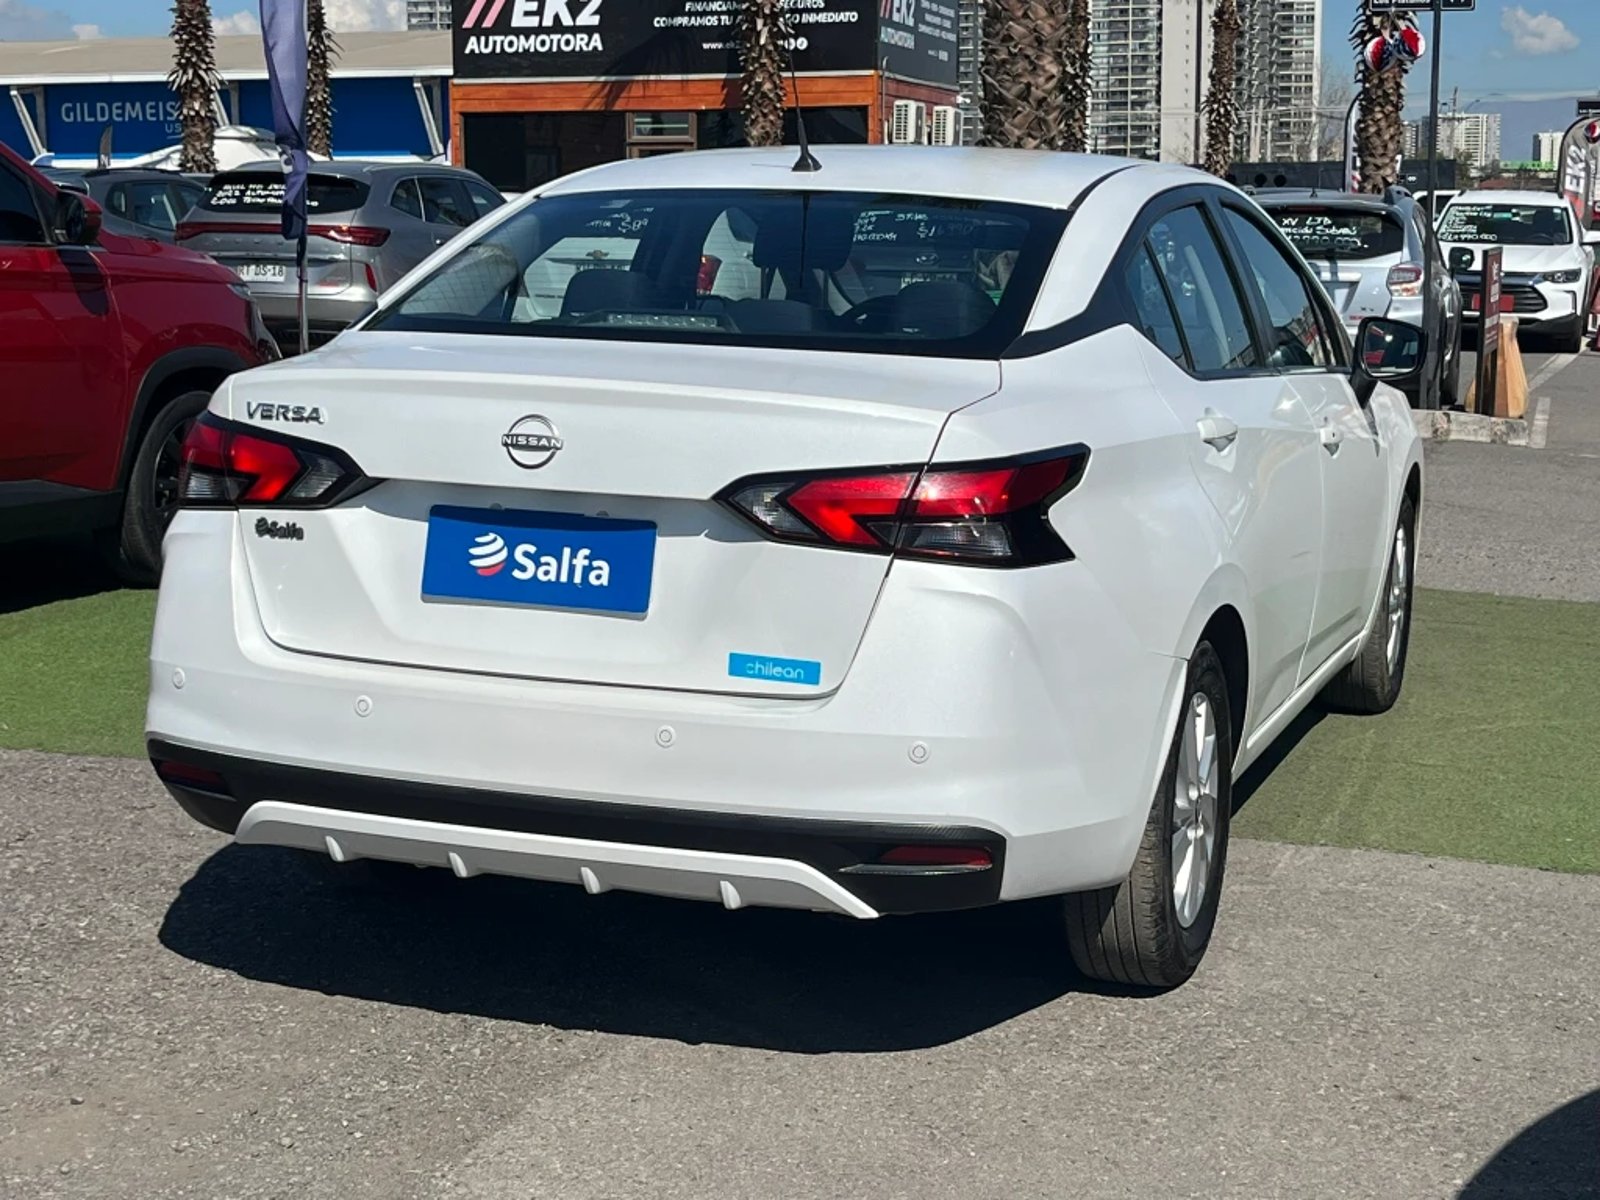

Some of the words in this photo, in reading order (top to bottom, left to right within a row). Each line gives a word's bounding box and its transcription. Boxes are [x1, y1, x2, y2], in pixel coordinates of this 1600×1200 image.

[510, 0, 601, 28] EK2
[653, 16, 719, 27] COMPRAMOS
[721, 16, 733, 26] TU
[801, 12, 859, 23] INMEDIATO
[464, 33, 604, 54] AUTOMOTORA
[60, 102, 182, 123] GILDEMEIS
[246, 401, 325, 425] VERSA
[502, 435, 562, 448] NISSAN
[511, 543, 610, 587] Salfa
[746, 660, 805, 681] chilean
